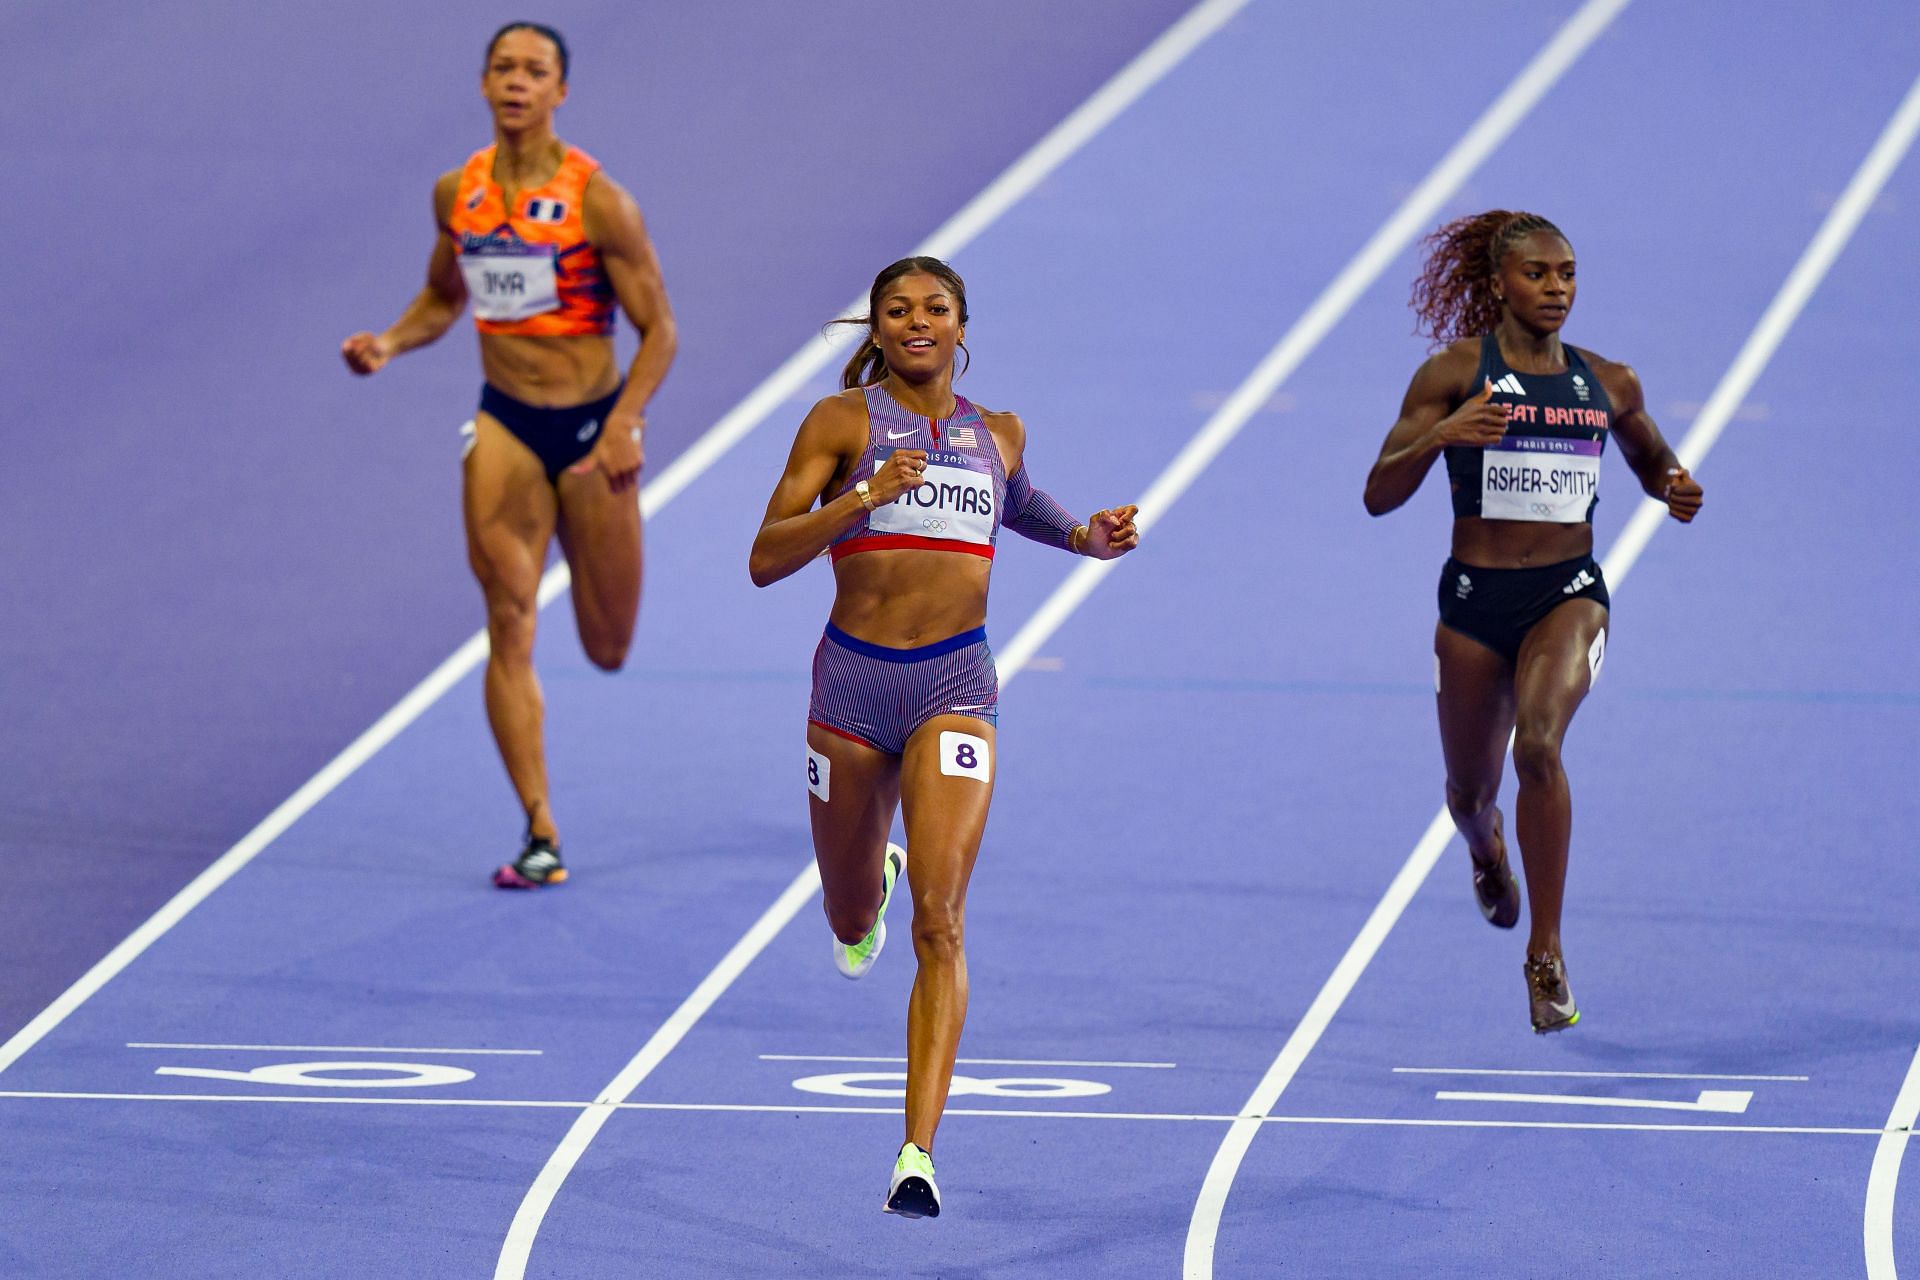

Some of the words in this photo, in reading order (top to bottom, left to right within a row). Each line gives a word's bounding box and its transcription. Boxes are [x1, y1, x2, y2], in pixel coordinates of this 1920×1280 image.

[1490, 402, 1538, 424] EAT
[1544, 406, 1609, 429] BRITAIN
[943, 454, 967, 465] 2024
[1516, 440, 1545, 450] PARIS
[1548, 442, 1575, 452] 2024
[1487, 465, 1597, 496] ASHER-SMITH
[955, 743, 978, 769] 8
[807, 756, 820, 786] 8
[791, 1071, 1113, 1098] 8
